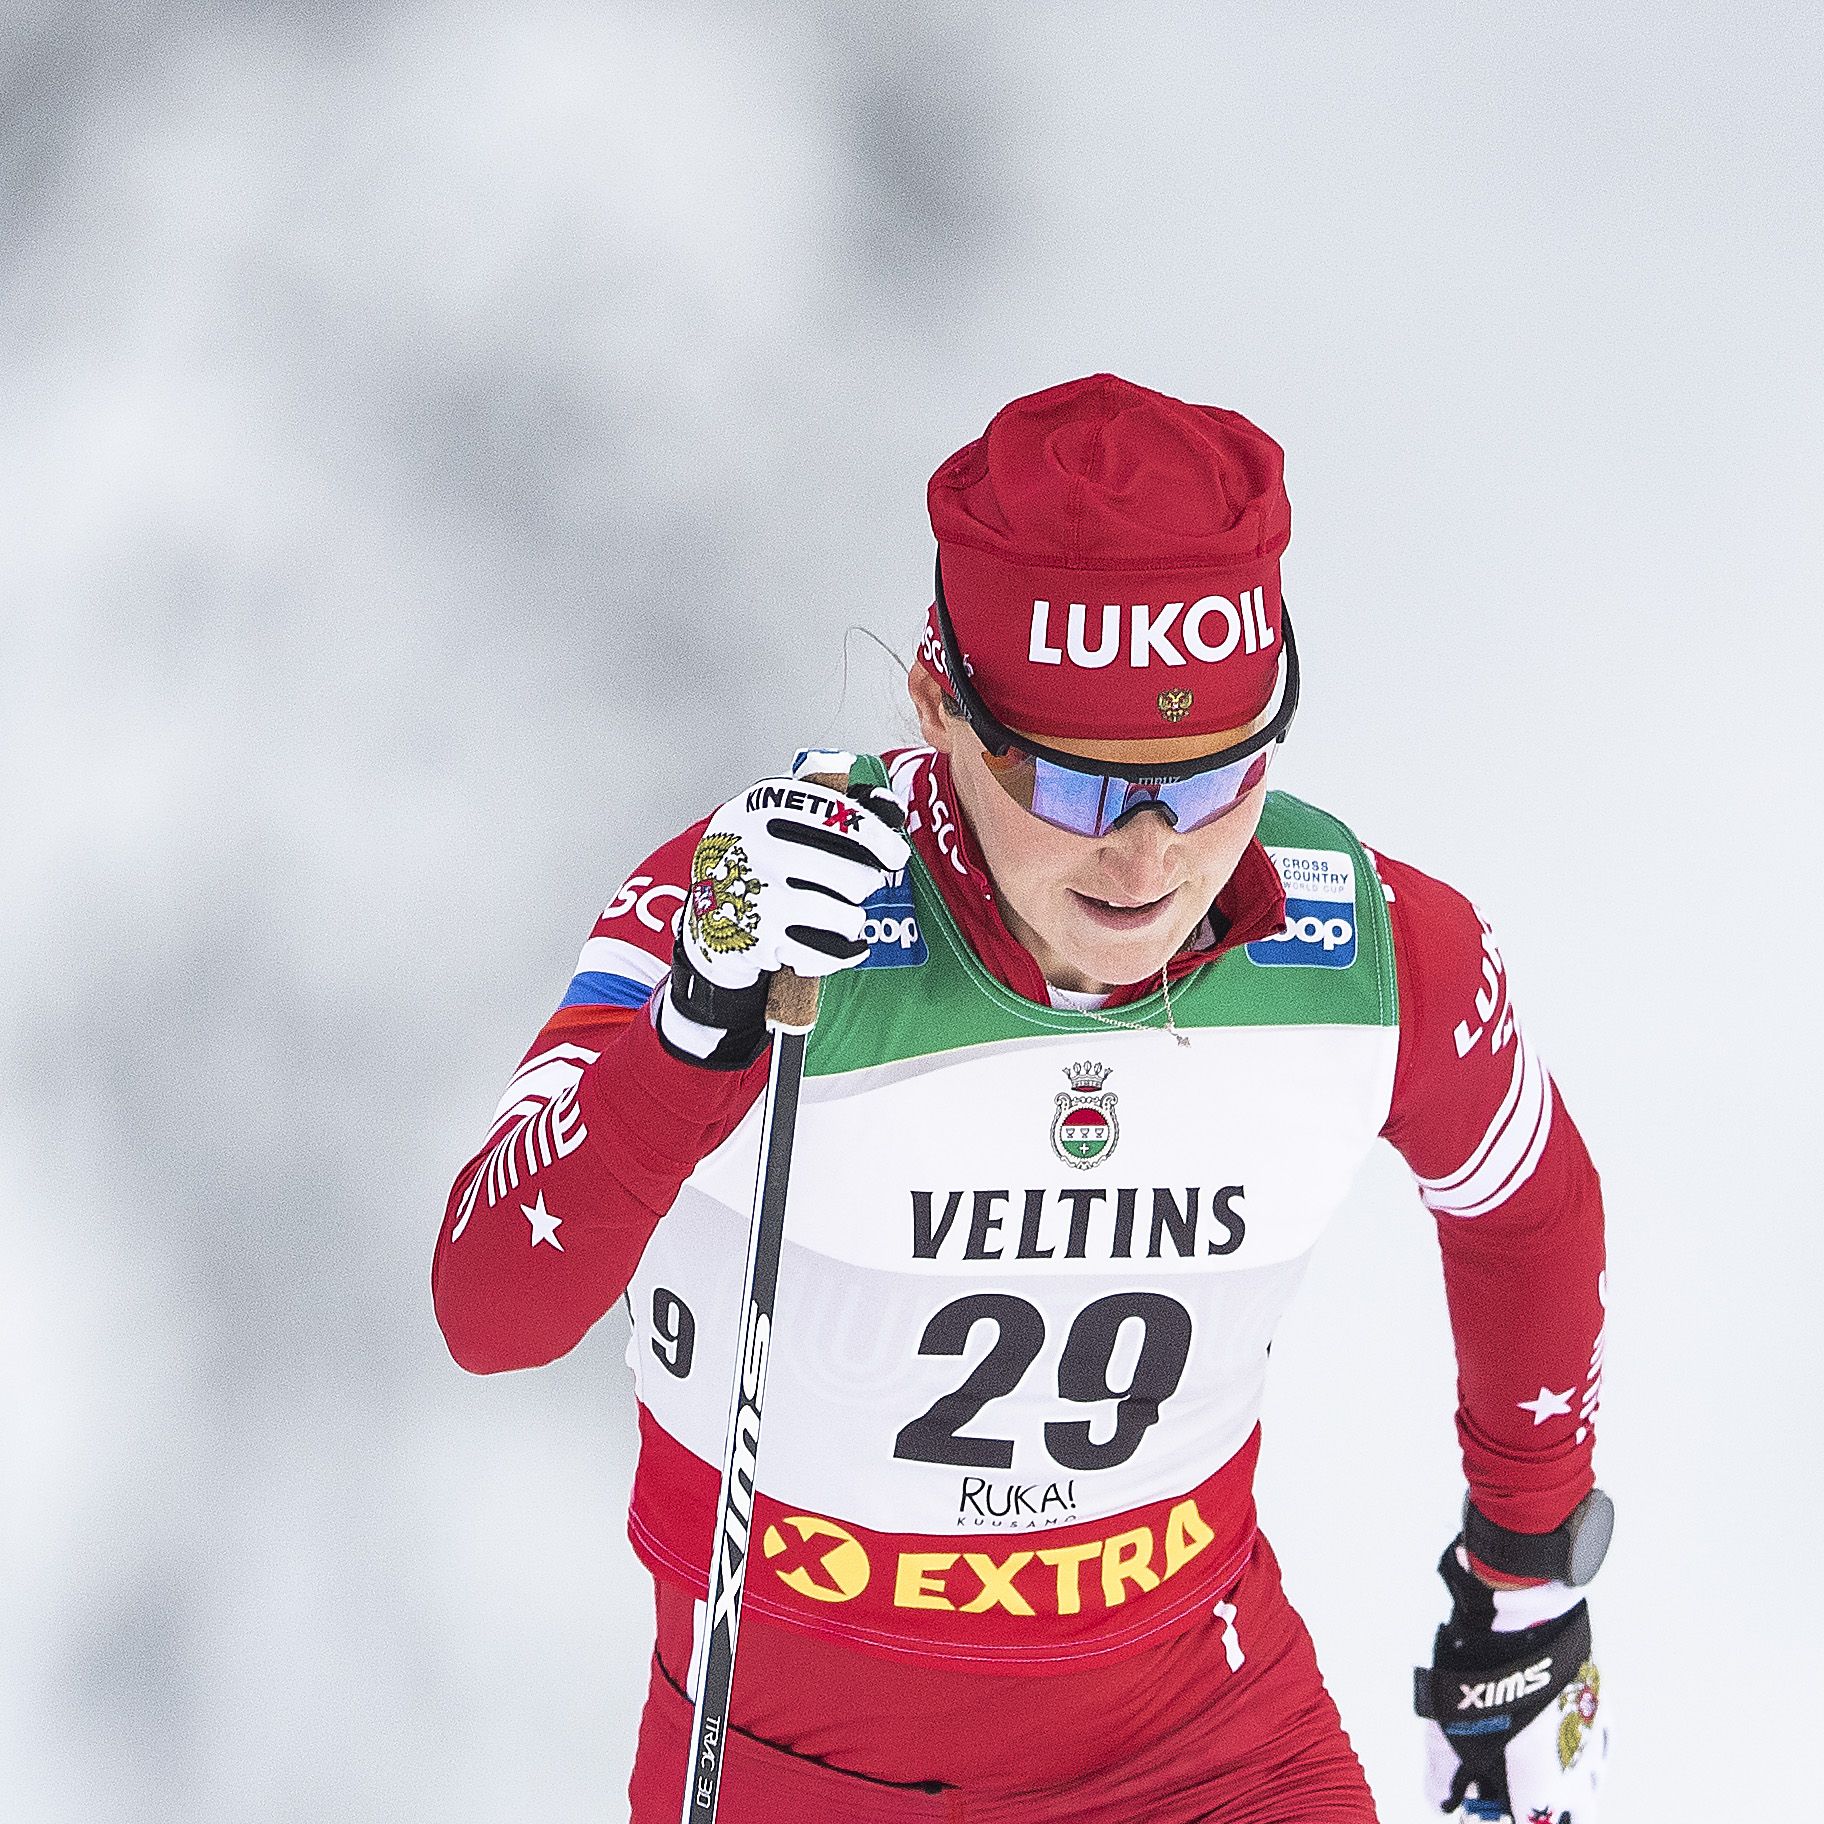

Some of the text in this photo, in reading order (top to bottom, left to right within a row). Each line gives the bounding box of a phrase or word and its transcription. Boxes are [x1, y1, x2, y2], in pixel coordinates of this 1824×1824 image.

[1028, 586, 1275, 669] LUKOIL
[1282, 858, 1329, 872] CROSS
[1283, 869, 1349, 885] COUNTRY
[1283, 881, 1345, 894] WORLD CUP
[910, 1184, 1247, 1261] VELTINS
[893, 1292, 1194, 1470] 29
[959, 1476, 1076, 1517] RUKA!
[894, 1499, 1215, 1617] EXTRA
